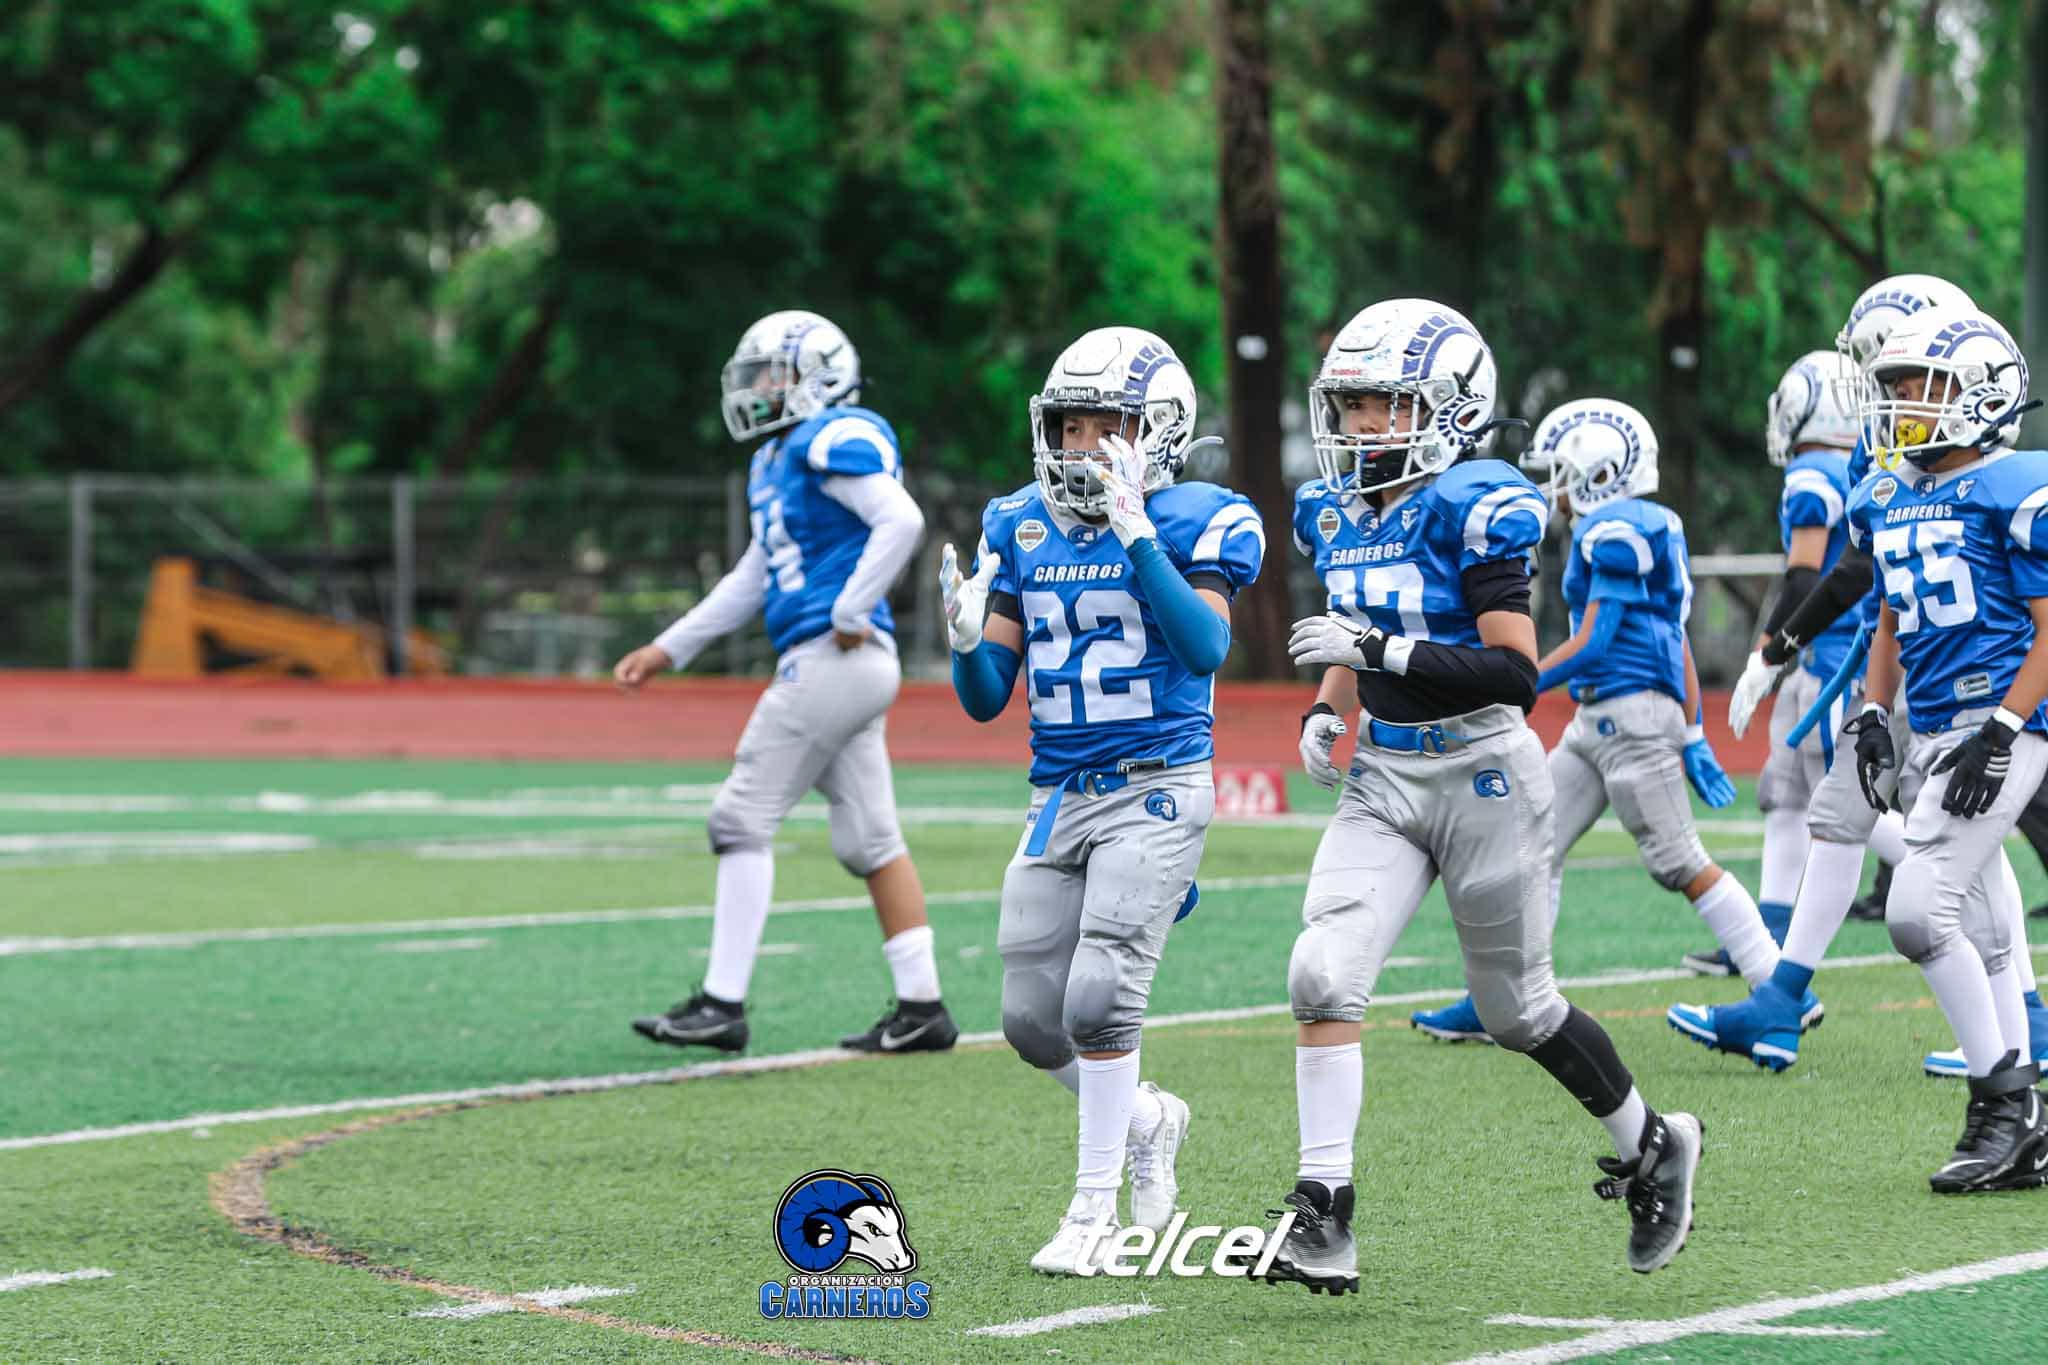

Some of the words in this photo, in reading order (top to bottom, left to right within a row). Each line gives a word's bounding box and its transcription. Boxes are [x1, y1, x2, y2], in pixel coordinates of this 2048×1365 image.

[1886, 504, 1952, 524] CARNEROS
[1331, 542, 1404, 565] CARNEROS
[1034, 563, 1123, 583] CARNEROS
[1873, 520, 1977, 632] 55
[1022, 590, 1153, 724] 22
